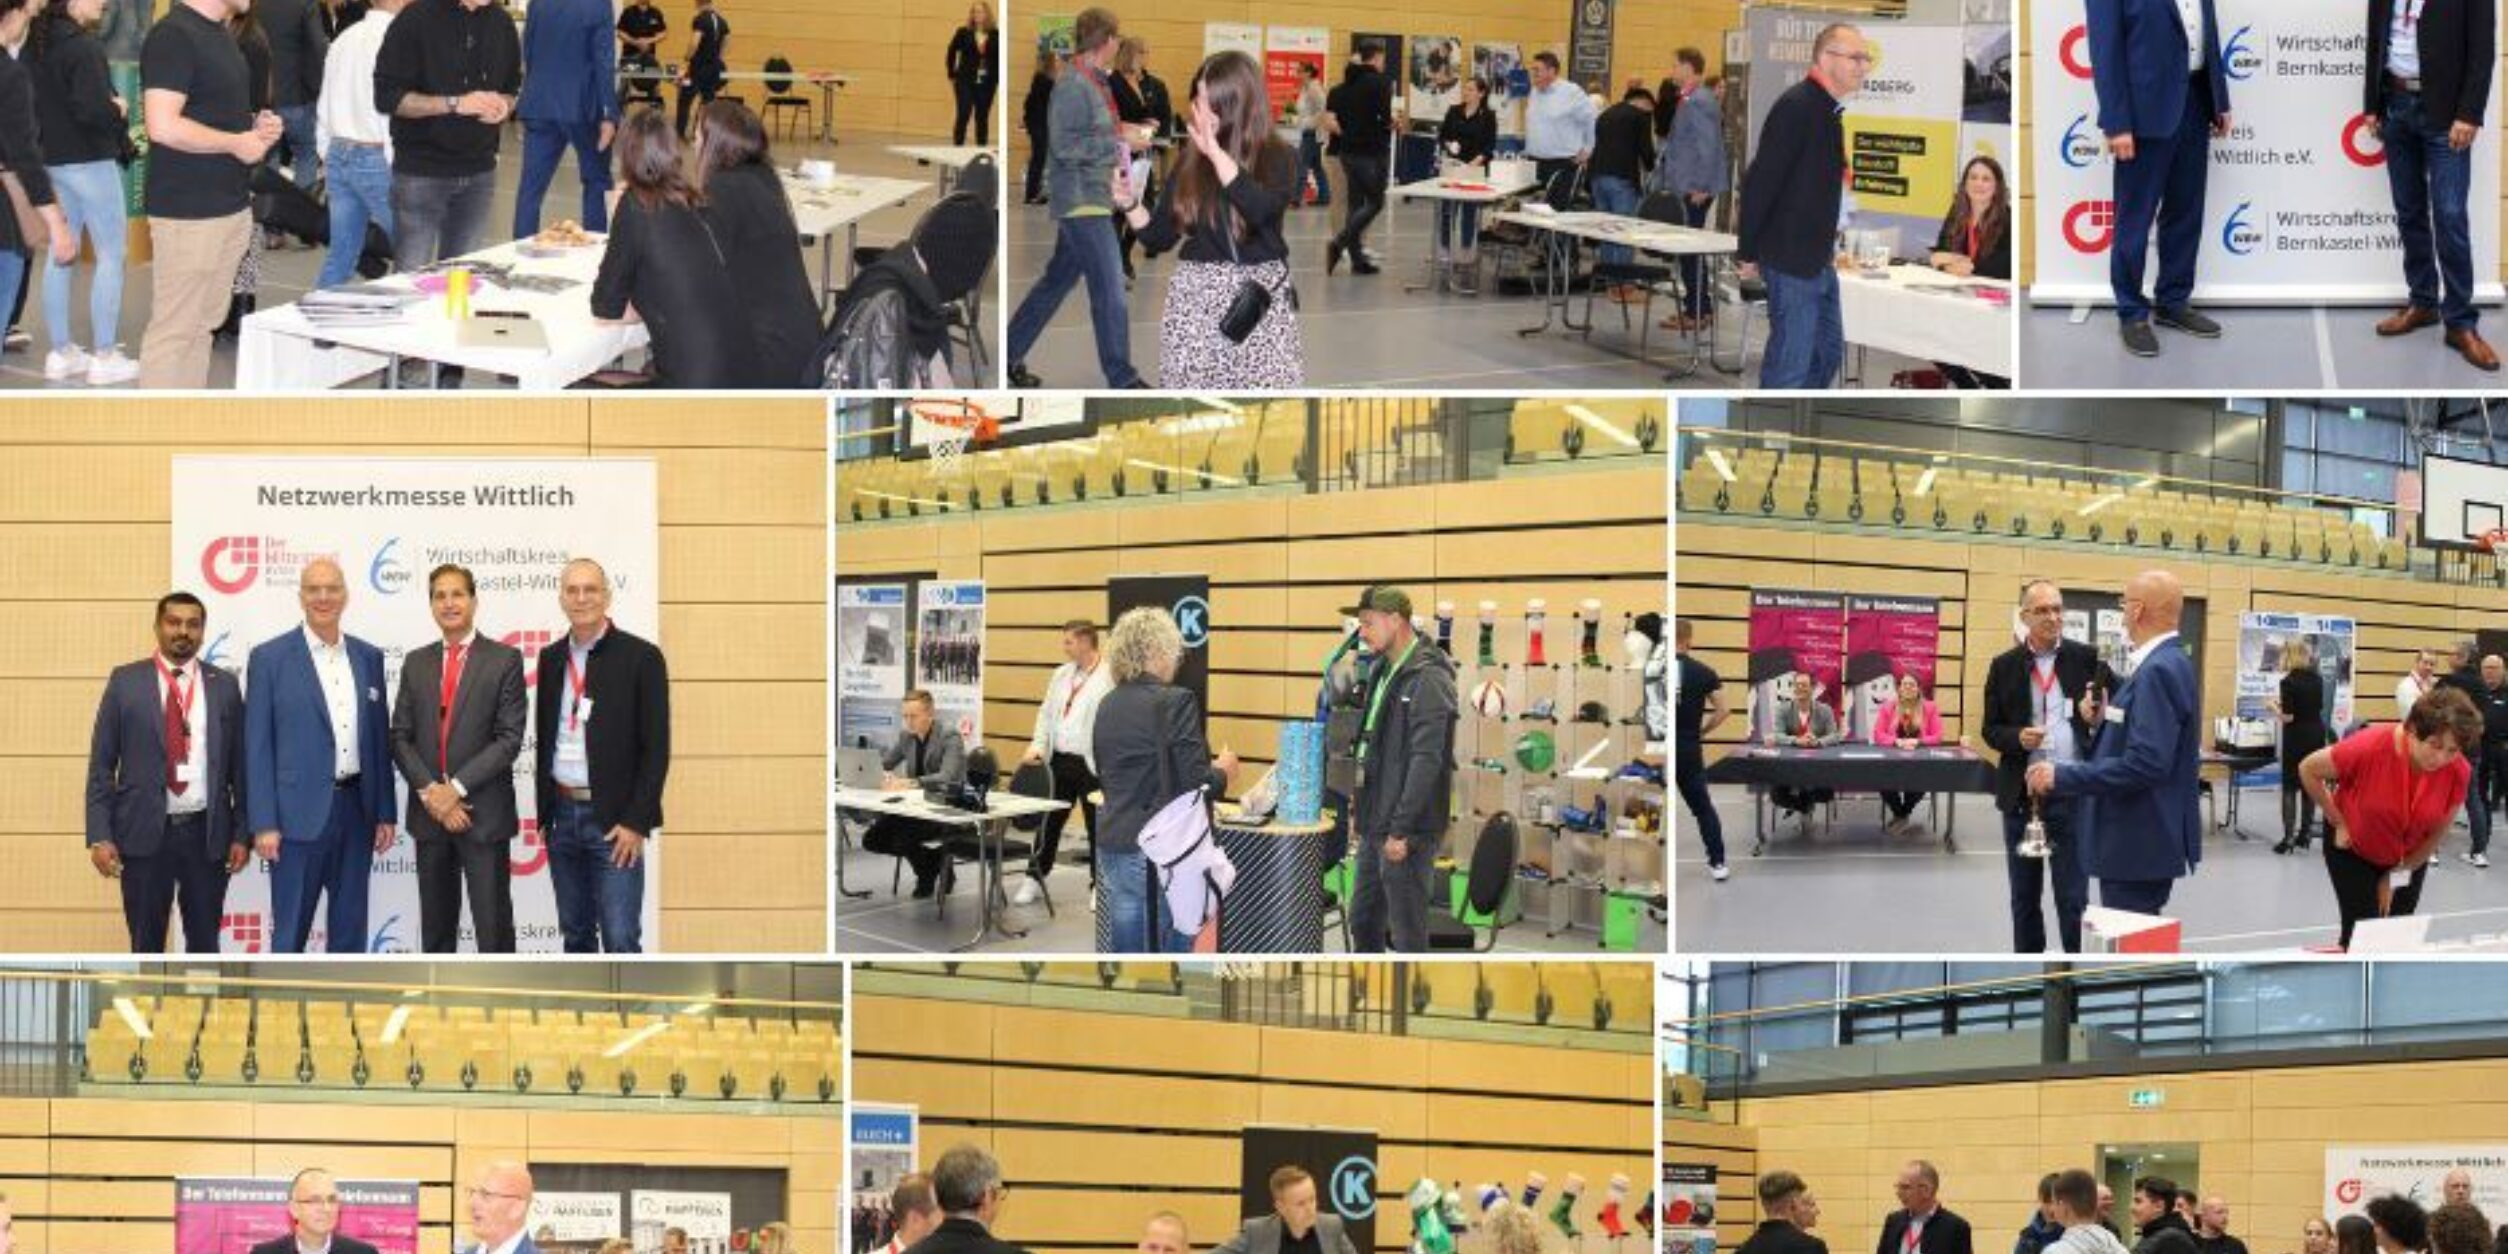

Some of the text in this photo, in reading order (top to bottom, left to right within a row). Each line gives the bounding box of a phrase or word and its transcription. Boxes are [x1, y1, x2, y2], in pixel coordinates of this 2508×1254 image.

[2276, 34, 2367, 52] Wirtschaft
[2276, 60, 2365, 76] Bernkaste
[2213, 147, 2314, 164] Wittlich e.V.
[2276, 210, 2400, 227] Wirtschaftskre
[2276, 234, 2404, 251] Bernkastel-Wi
[257, 485, 575, 506] Netzwerkmesse Wittlich
[1180, 607, 1203, 637] K
[336, 1188, 412, 1204] elefonmann
[1343, 1170, 1371, 1205] K
